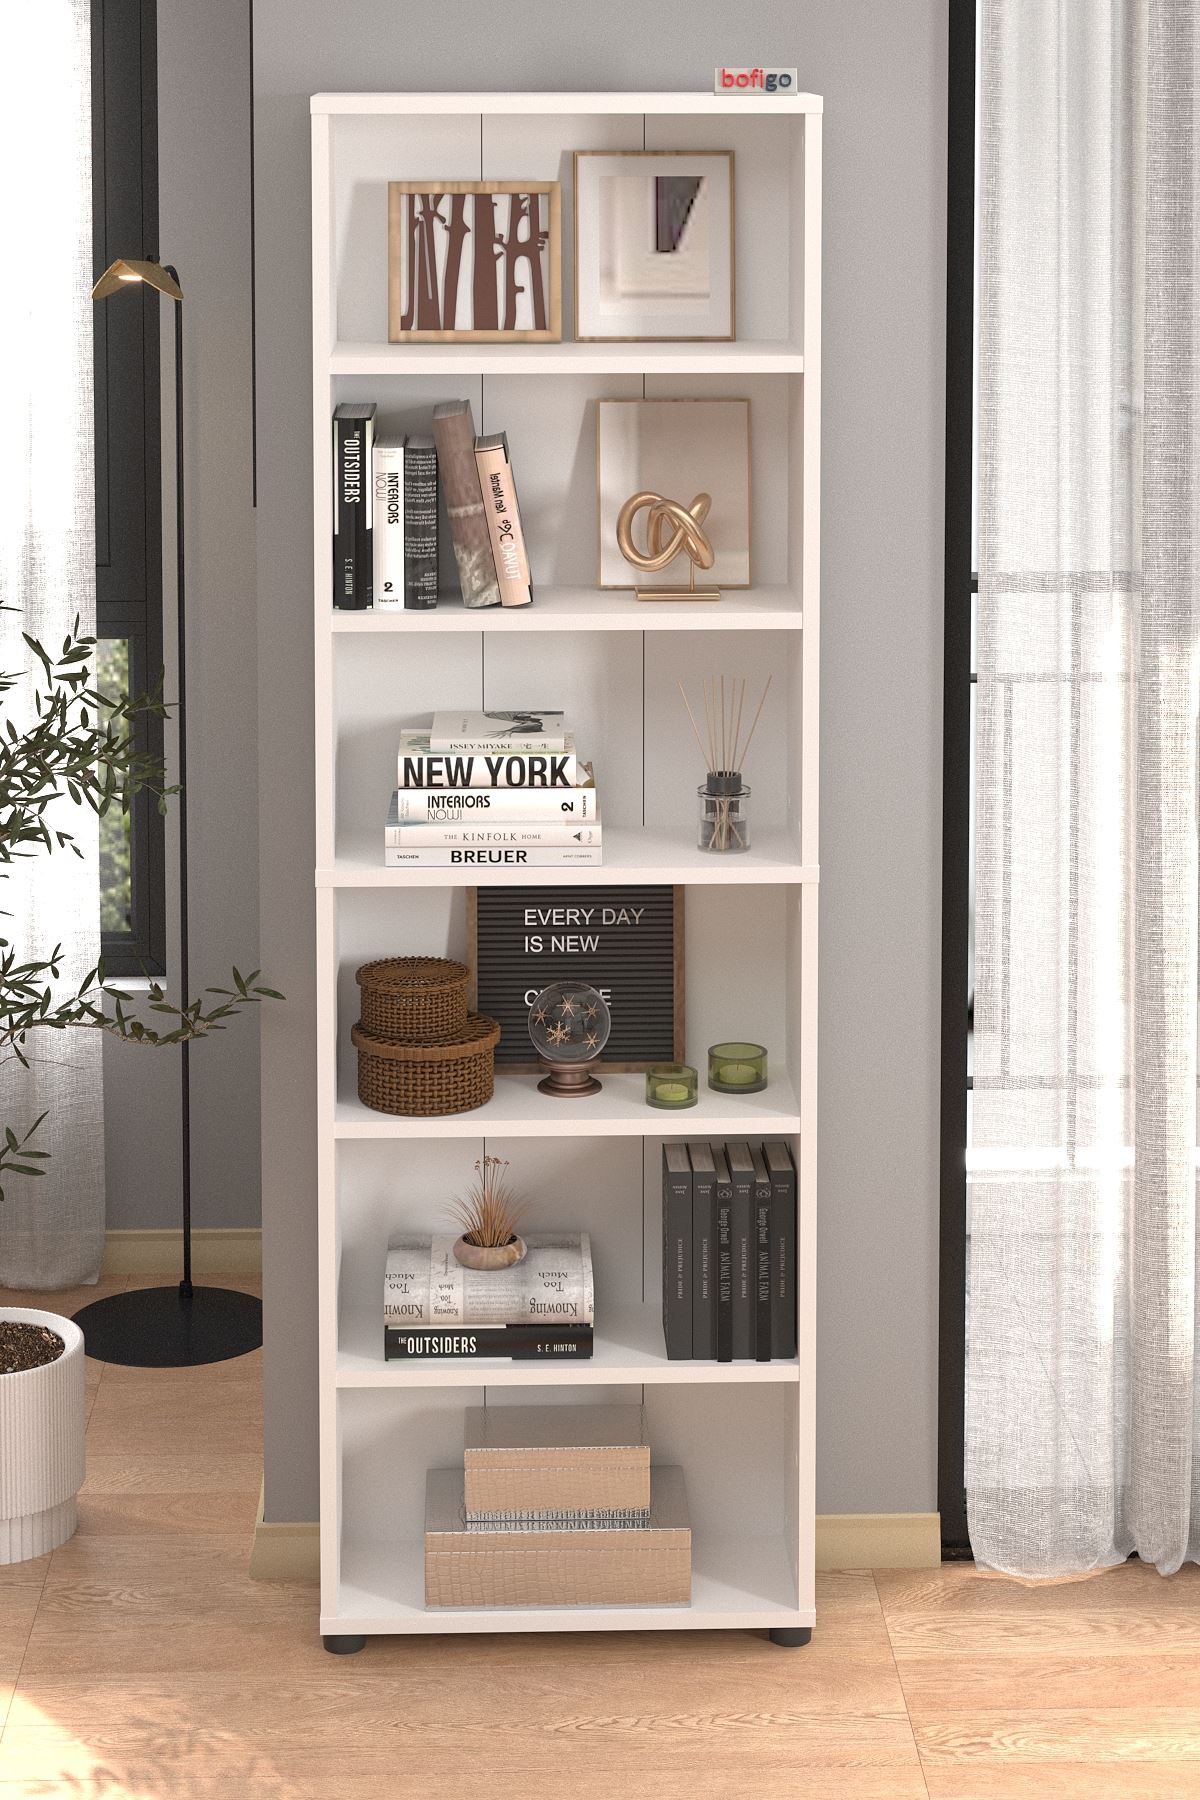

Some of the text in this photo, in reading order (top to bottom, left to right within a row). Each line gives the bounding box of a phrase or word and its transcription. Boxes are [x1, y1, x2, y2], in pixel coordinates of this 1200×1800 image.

[721, 68, 792, 92] bofigo
[344, 440, 361, 503] OUTSIDERS
[387, 472, 400, 524] INTERIORS
[384, 582, 394, 592] 2
[404, 756, 570, 787] NEW YORK
[428, 796, 490, 808] INTERIORS
[562, 802, 574, 812] 2
[428, 809, 462, 820] NOW!
[462, 832, 517, 841] KINFOLK
[451, 850, 527, 863] BREUER
[524, 908, 645, 926] EVERY DAY
[524, 936, 600, 953] IS NEW
[718, 1208, 732, 1302] George Orwell ANIMAL FARM
[757, 1208, 770, 1301] George Orwell ANIMAL FARM
[390, 1283, 409, 1293] Too
[543, 1281, 564, 1291] Too
[434, 1306, 459, 1316] Knowing
[530, 1297, 578, 1316] Knowing
[407, 1336, 477, 1354] OUTSIDERS
[553, 1344, 577, 1352] HINTON
